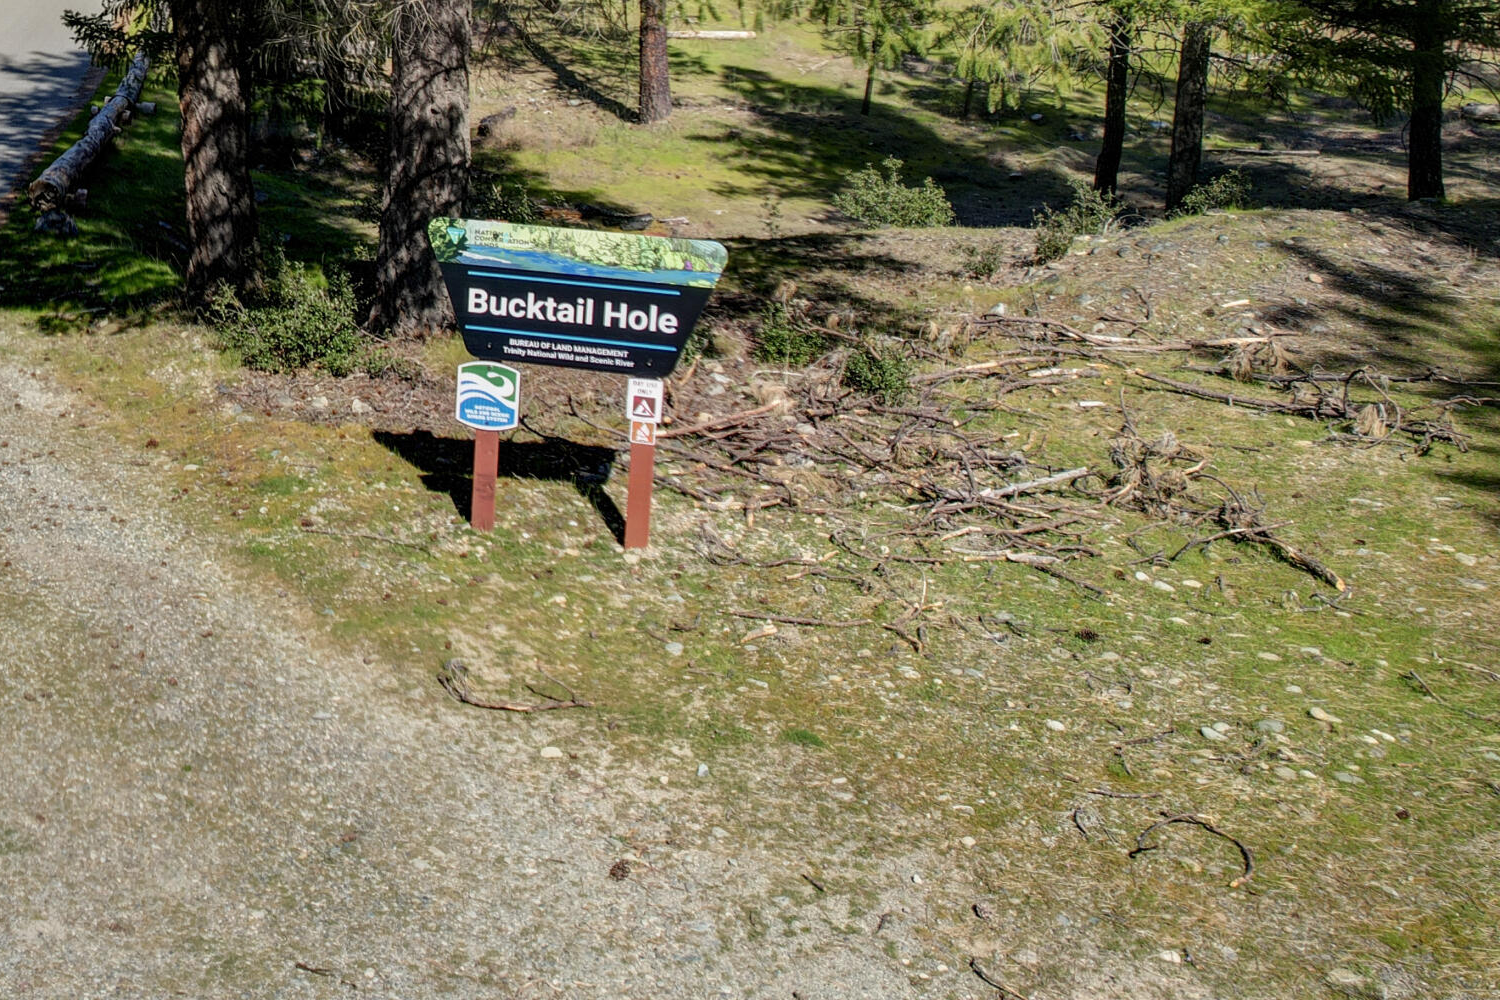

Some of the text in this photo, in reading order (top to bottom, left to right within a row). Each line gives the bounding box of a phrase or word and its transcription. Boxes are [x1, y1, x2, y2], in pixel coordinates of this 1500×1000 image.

[467, 287, 679, 334] Bucktail Hole
[503, 346, 635, 368] Trinity National Wild and Scenic River
[509, 338, 629, 358] BUREAU OF LAND MANAGEMENT
